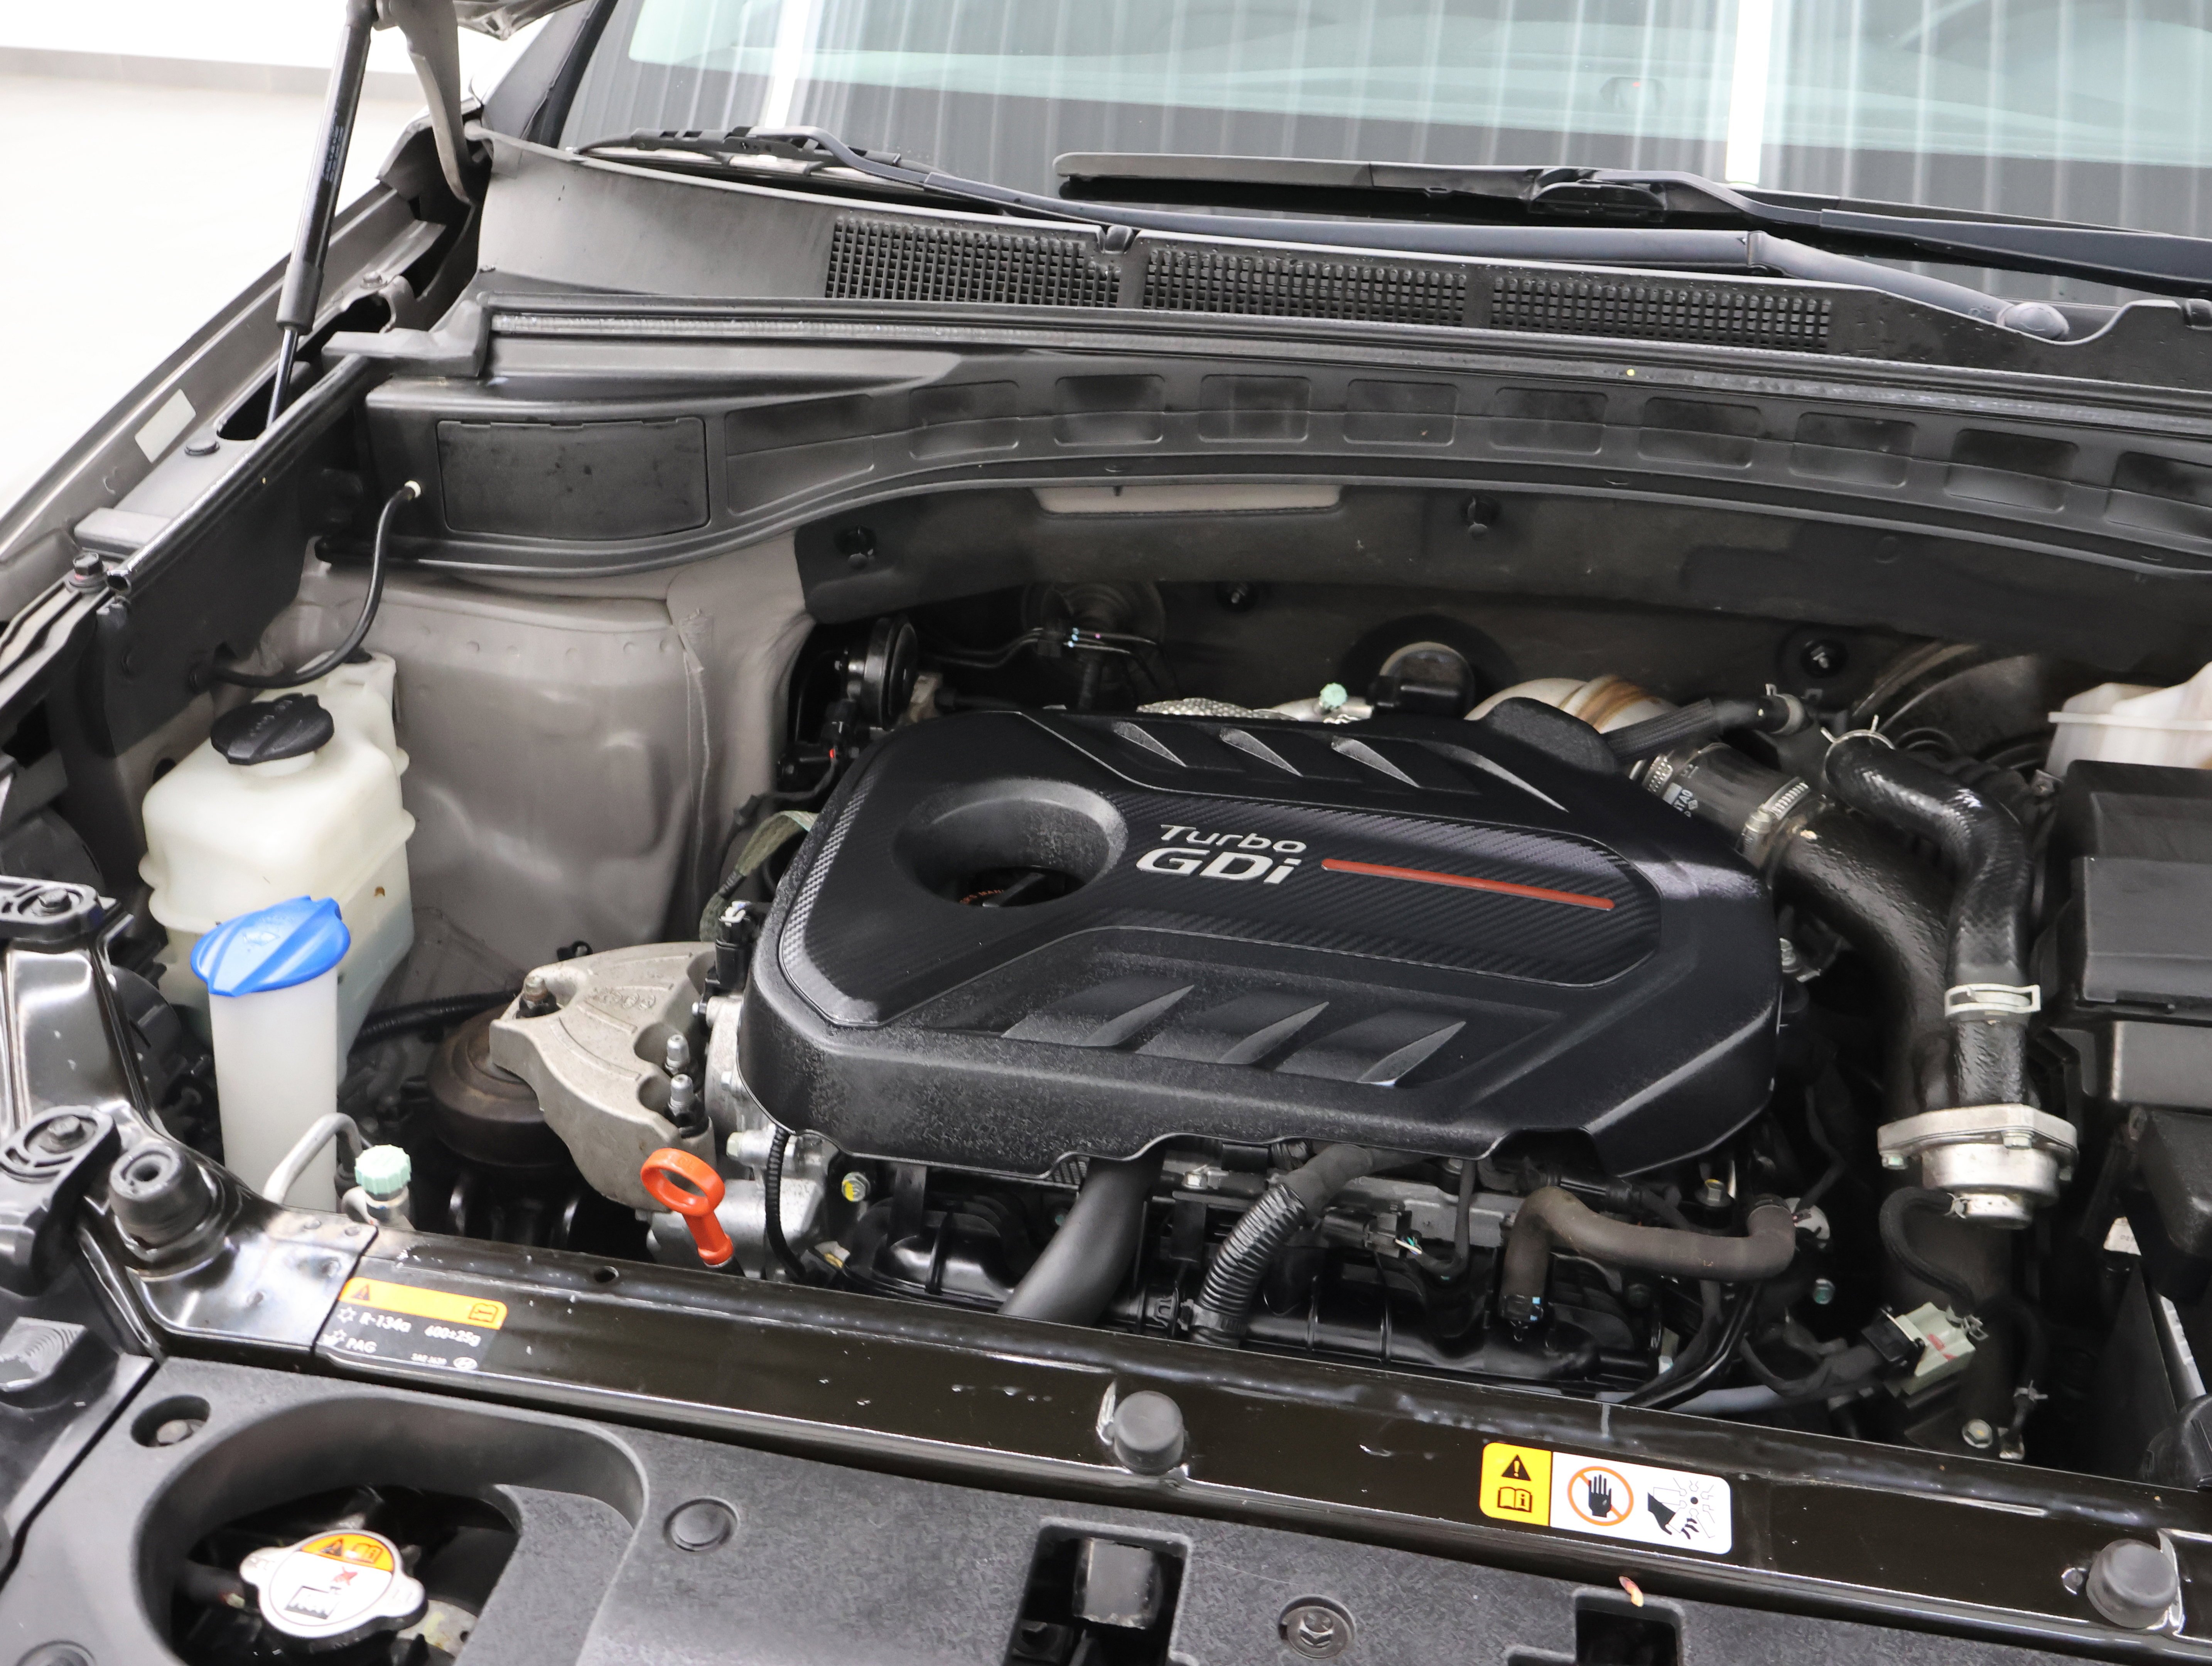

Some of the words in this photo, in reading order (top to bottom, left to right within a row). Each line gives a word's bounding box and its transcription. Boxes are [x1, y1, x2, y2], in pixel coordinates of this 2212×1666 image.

[1161, 824, 1307, 853] Turbo
[1136, 847, 1302, 884] GDi
[345, 1337, 377, 1354] PAG
[359, 1312, 412, 1333] R-134a
[424, 1325, 481, 1347] 600±25g
